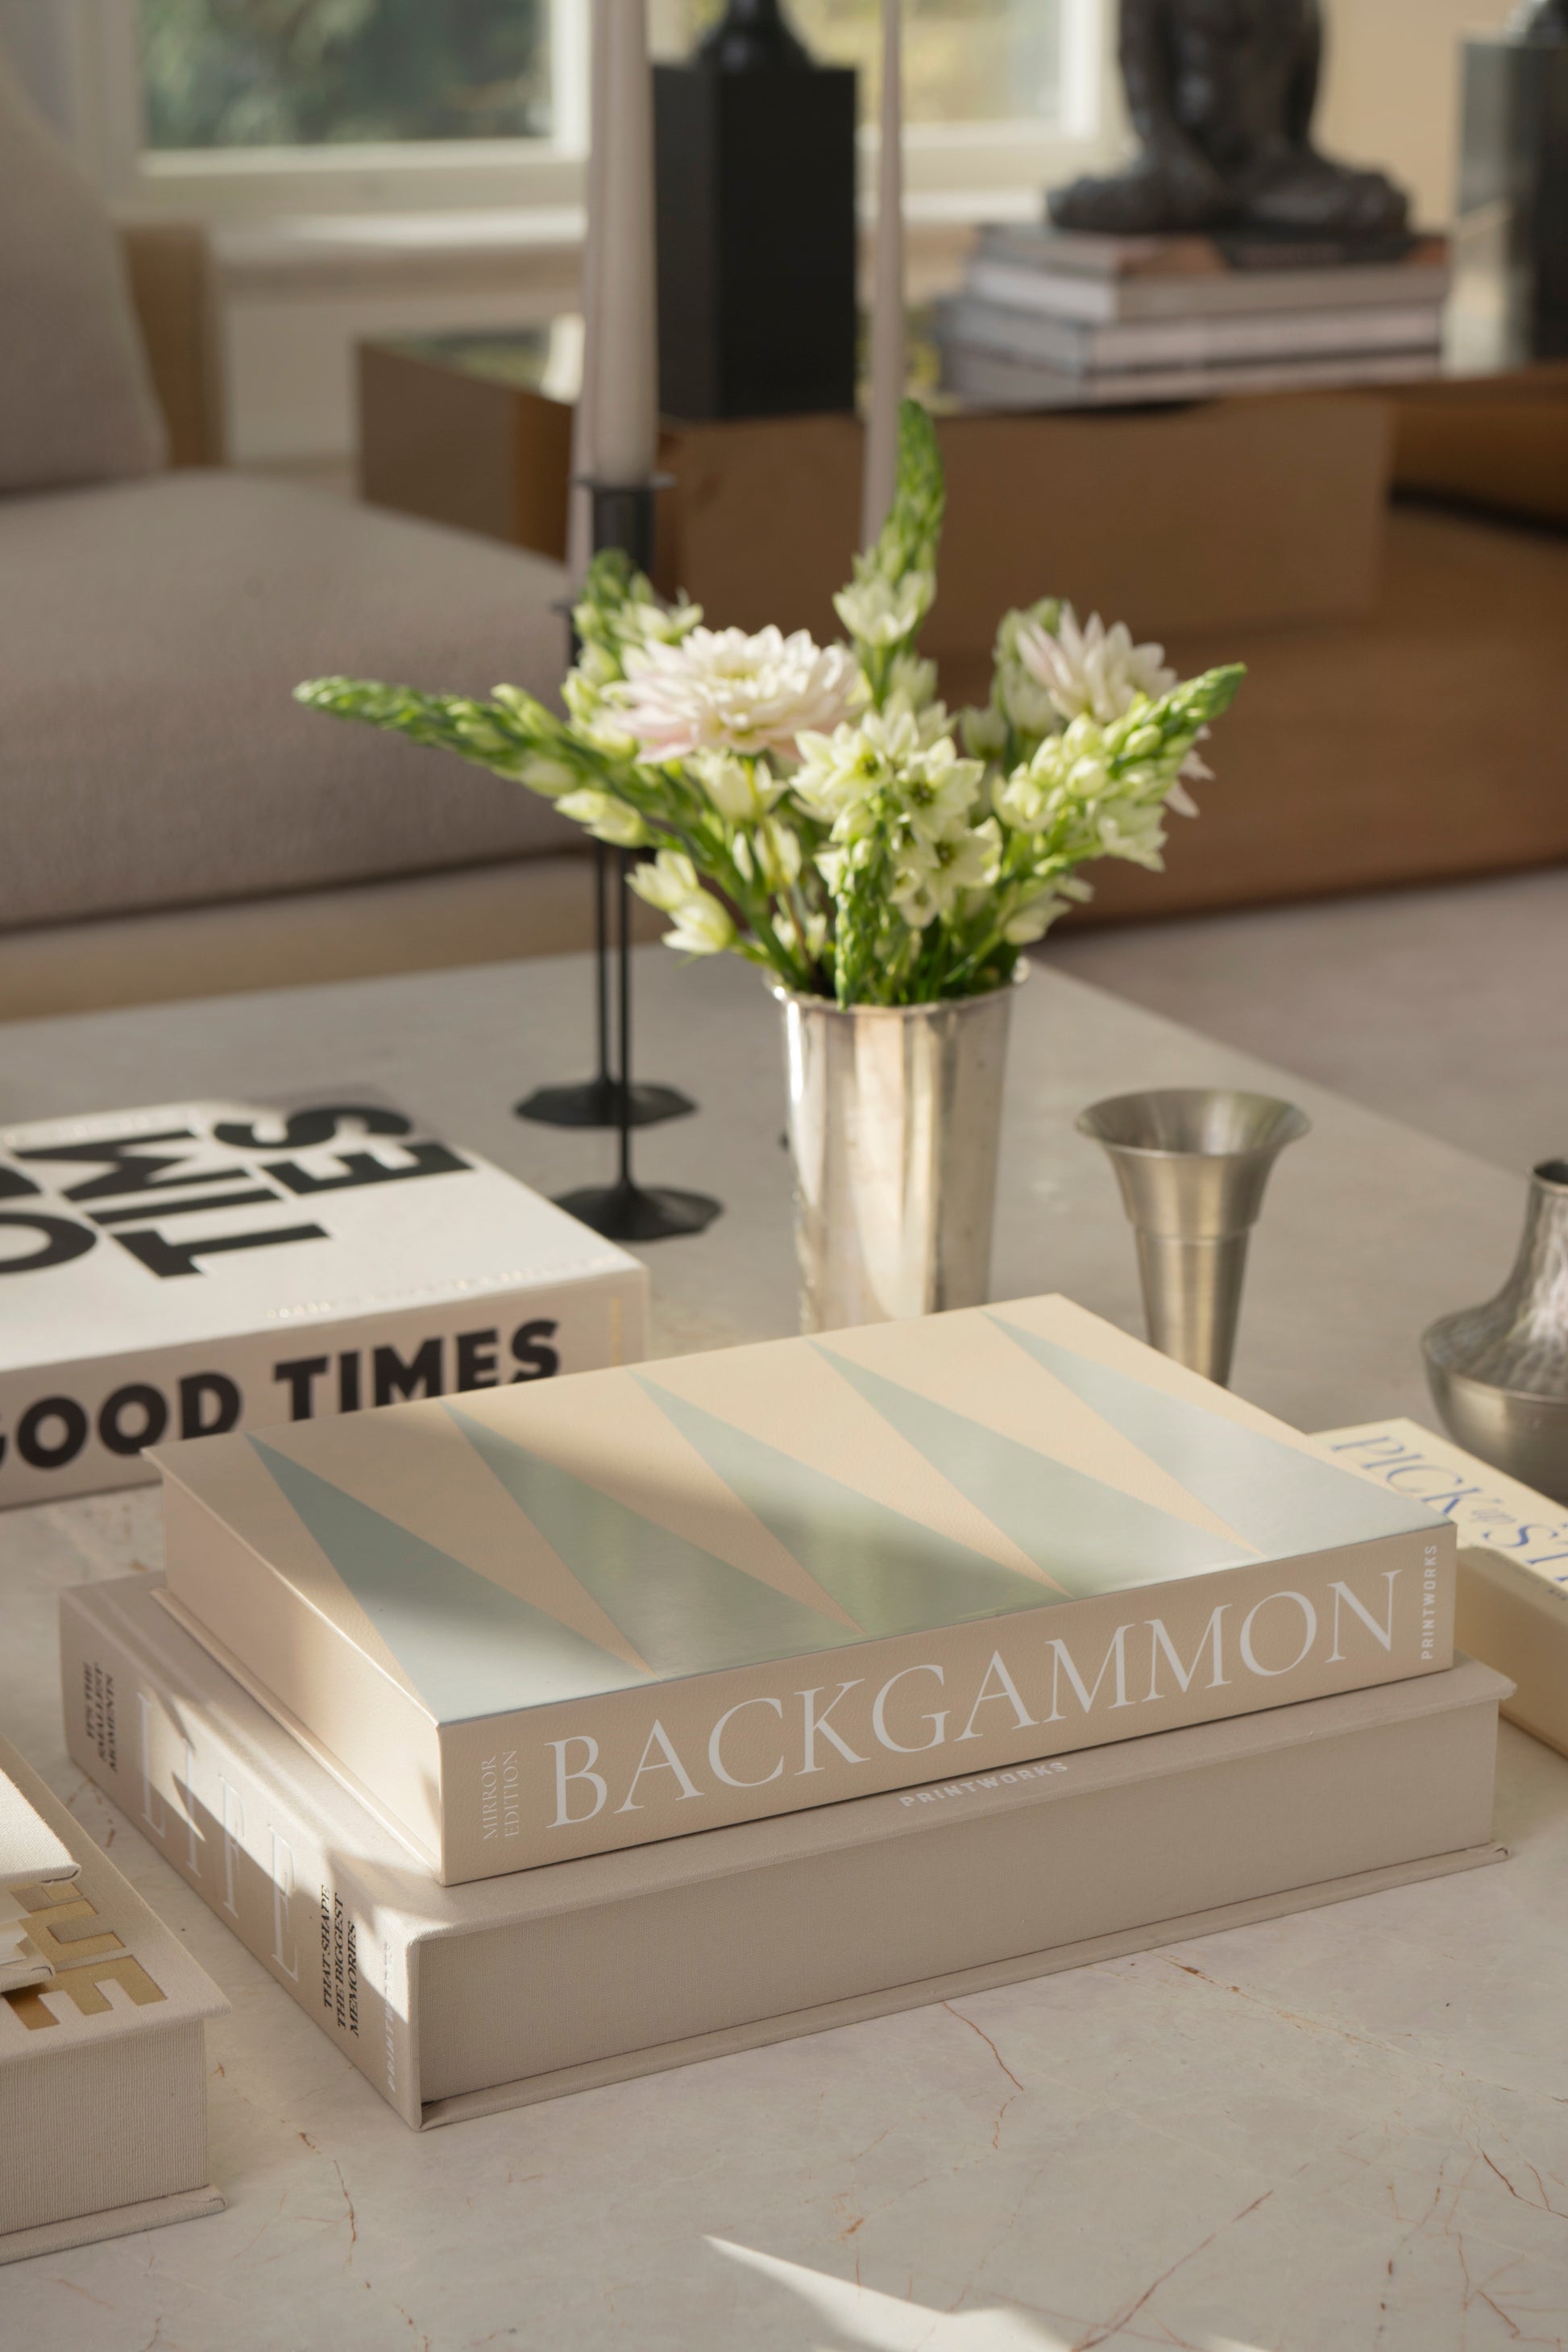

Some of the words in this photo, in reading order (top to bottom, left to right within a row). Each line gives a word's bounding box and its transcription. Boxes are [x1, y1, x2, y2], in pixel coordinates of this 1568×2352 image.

[0, 1371, 243, 1470] OOD
[272, 1319, 561, 1423] TIMES
[1331, 1435, 1505, 1517] PICK
[1421, 1545, 1437, 1661] PRINTWORKS
[544, 1569, 1403, 1830] BACKGAMMON
[481, 1755, 498, 1840] MIRROR
[502, 1750, 520, 1838] EDITION
[898, 1761, 1068, 1807] PRINTWORKS
[321, 1885, 331, 1956] SHAPE
[334, 1892, 344, 1985] BIGGEST
[321, 1956, 333, 2011] THAT
[334, 1985, 346, 2031] THE
[347, 1920, 359, 2039] MEMORIES
